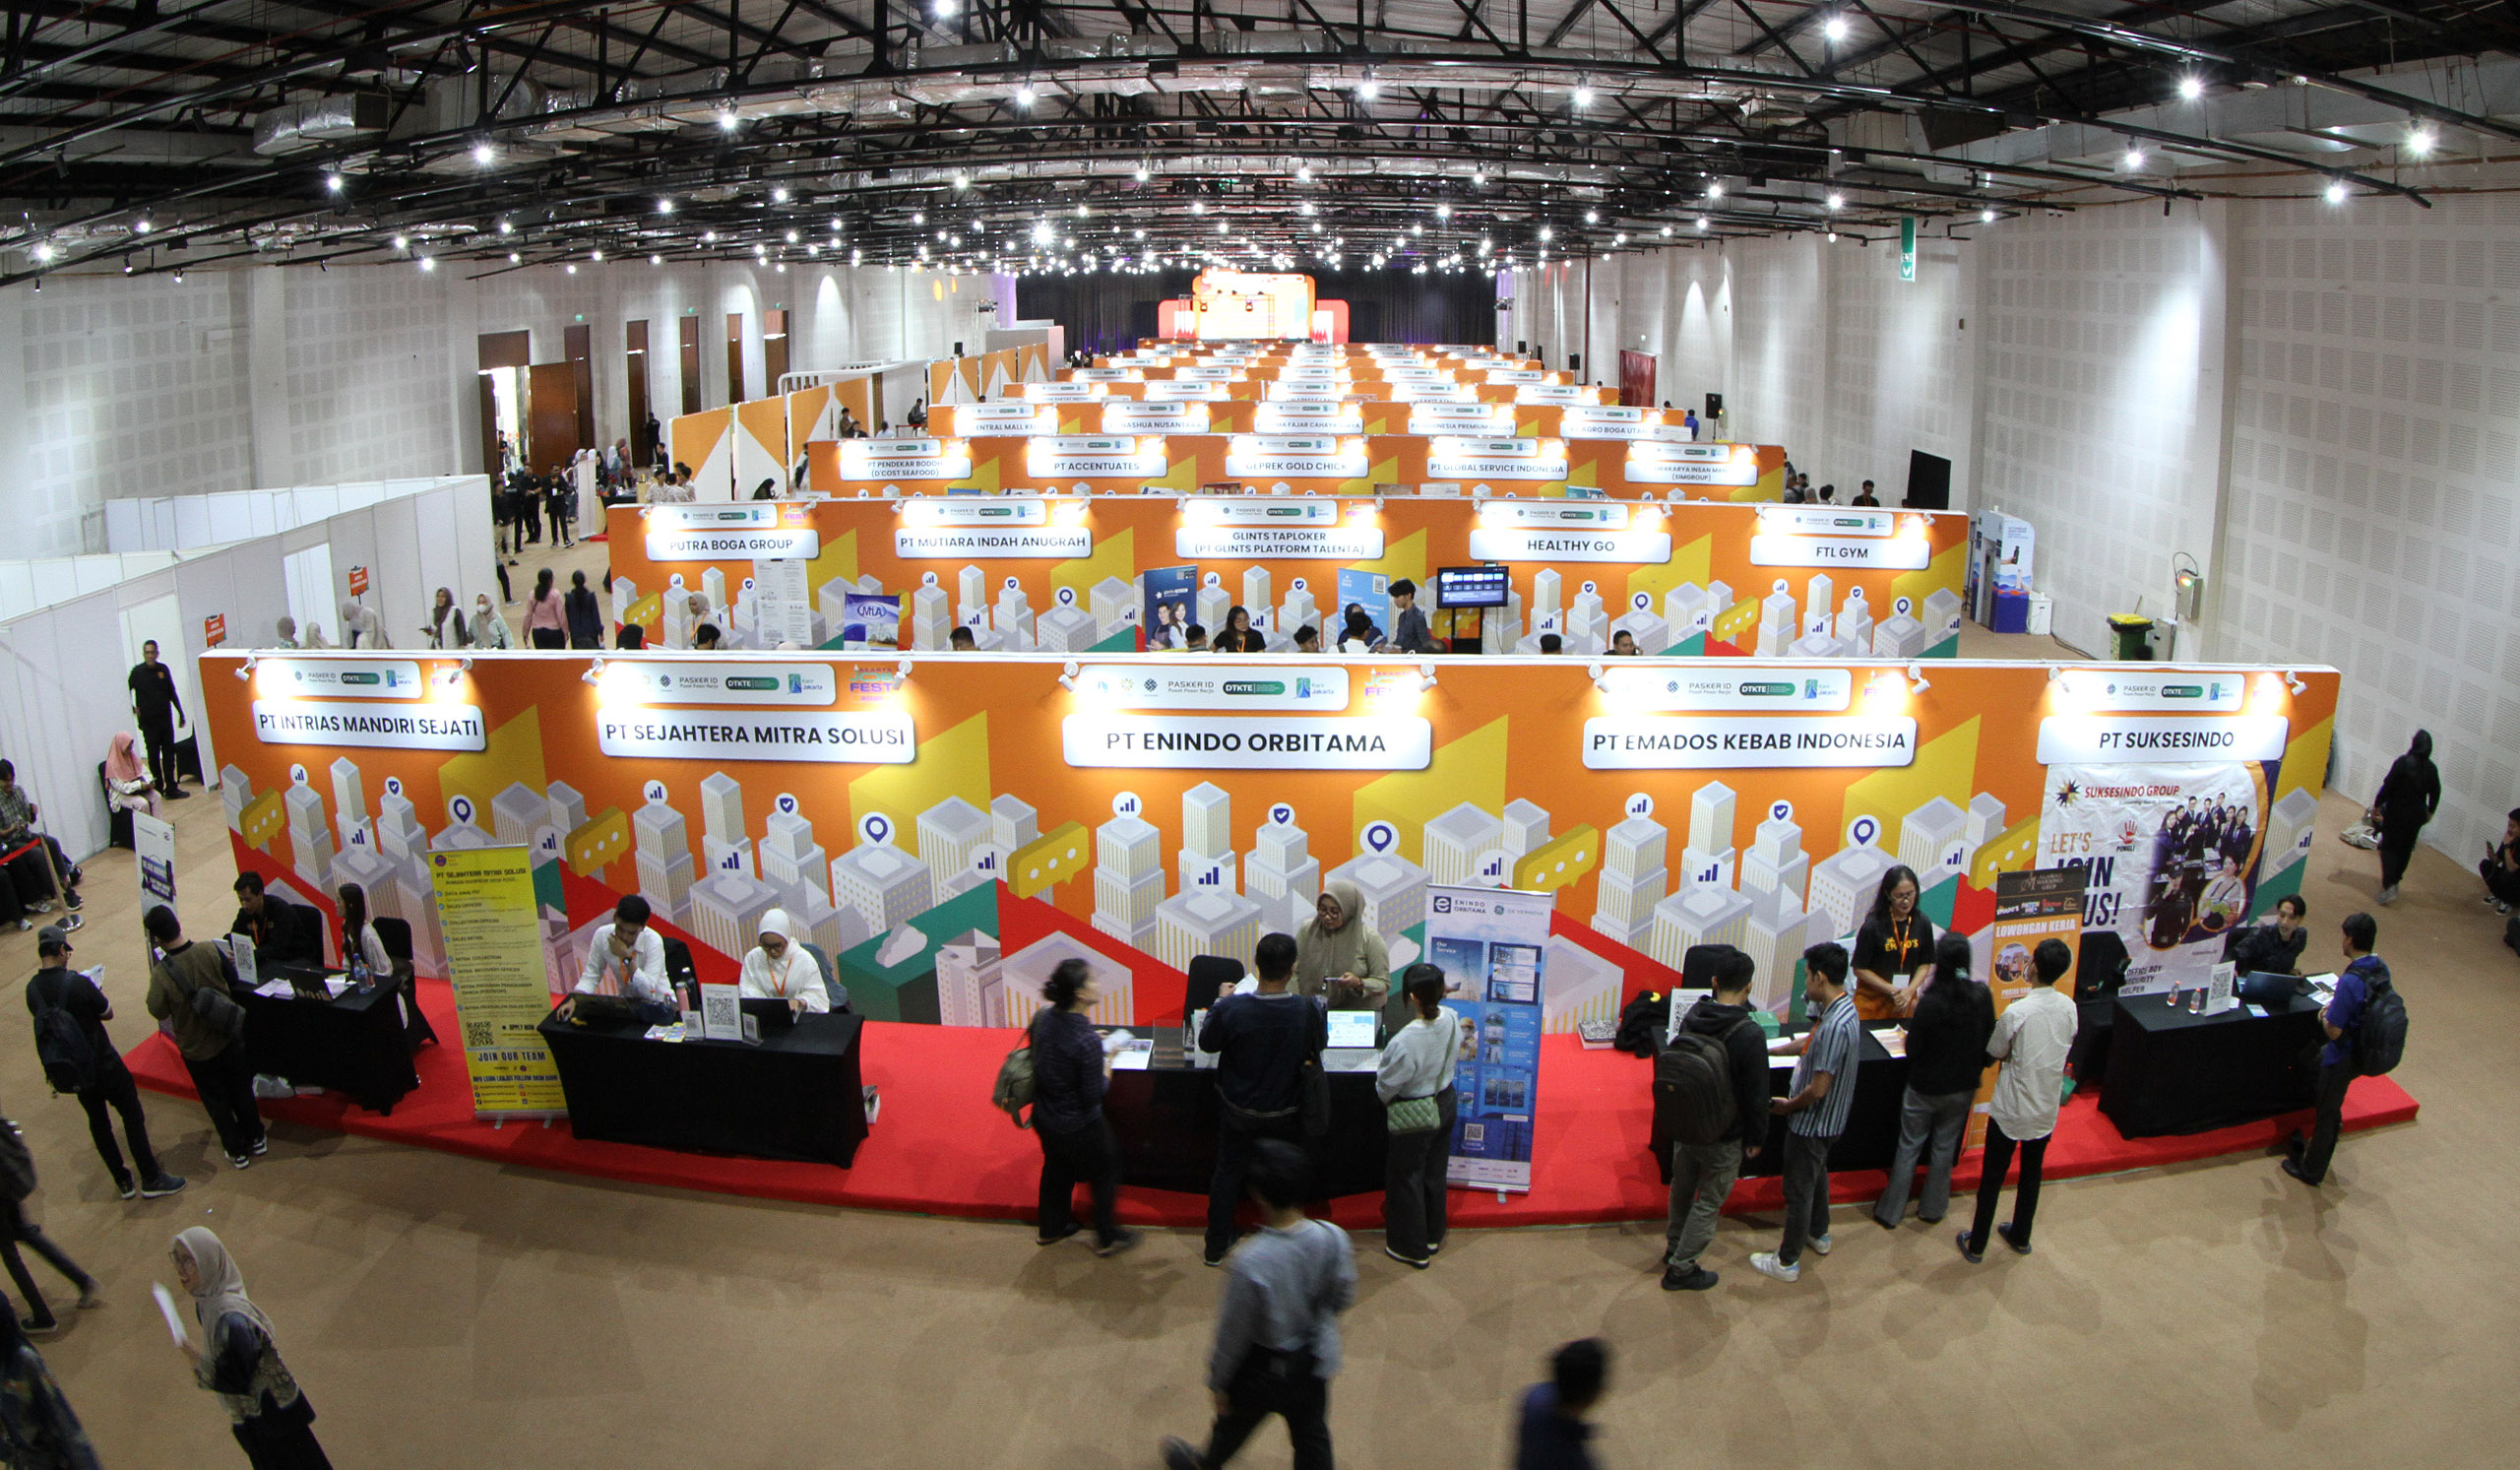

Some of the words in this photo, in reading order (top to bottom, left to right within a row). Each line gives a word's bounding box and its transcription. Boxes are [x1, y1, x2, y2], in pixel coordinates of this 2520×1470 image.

[901, 537, 914, 547] PT
[917, 537, 975, 547] MUTIARA
[977, 537, 1018, 547] INDAH
[1022, 537, 1086, 547] ANUGRAH
[1232, 532, 1270, 541] GLINTS
[1273, 532, 1326, 541] TAPLOKER
[669, 540, 709, 550] PUTRA
[712, 540, 746, 550] BOGA
[749, 539, 793, 549] GROUP
[1215, 544, 1251, 553] GLINTS
[1254, 544, 1310, 553] PLATFORM
[1528, 540, 1589, 551] HEALTHY
[1594, 541, 1614, 551] GO
[1816, 547, 1836, 557] FTL
[1839, 547, 1868, 558] GYM
[850, 670, 894, 681] JOB
[850, 683, 893, 692] FEST
[260, 714, 276, 729] PT
[281, 716, 340, 732] INTRIAS
[343, 716, 414, 734] MANDIRI
[418, 719, 478, 736] SEJATI
[606, 724, 628, 739] PT
[634, 725, 749, 743] SEJAHTERA
[755, 726, 822, 744] MITRA
[828, 728, 905, 745] SOLUSI
[2100, 733, 2121, 748] PT
[2125, 732, 2234, 748] SUKSESINDO
[1106, 734, 1136, 749] PT
[1143, 733, 1241, 751] ENINDO
[1247, 734, 1385, 752] ORBITAMA
[1594, 735, 1618, 750] PT
[1625, 735, 1718, 749] EMADOS
[1724, 734, 1791, 749] KEBAB
[1797, 733, 1906, 748] INDONESIA
[2085, 786, 2145, 798] SUKSESINDO
[2147, 785, 2179, 797] GROUP
[2050, 832, 2092, 854] LET'S
[1996, 922, 2048, 937] LOWONGAN
[2048, 919, 2076, 932] KERJA
[2120, 986, 2145, 994] HELPER
[478, 1052, 498, 1061] JOIN
[522, 1052, 545, 1060] TEAM
